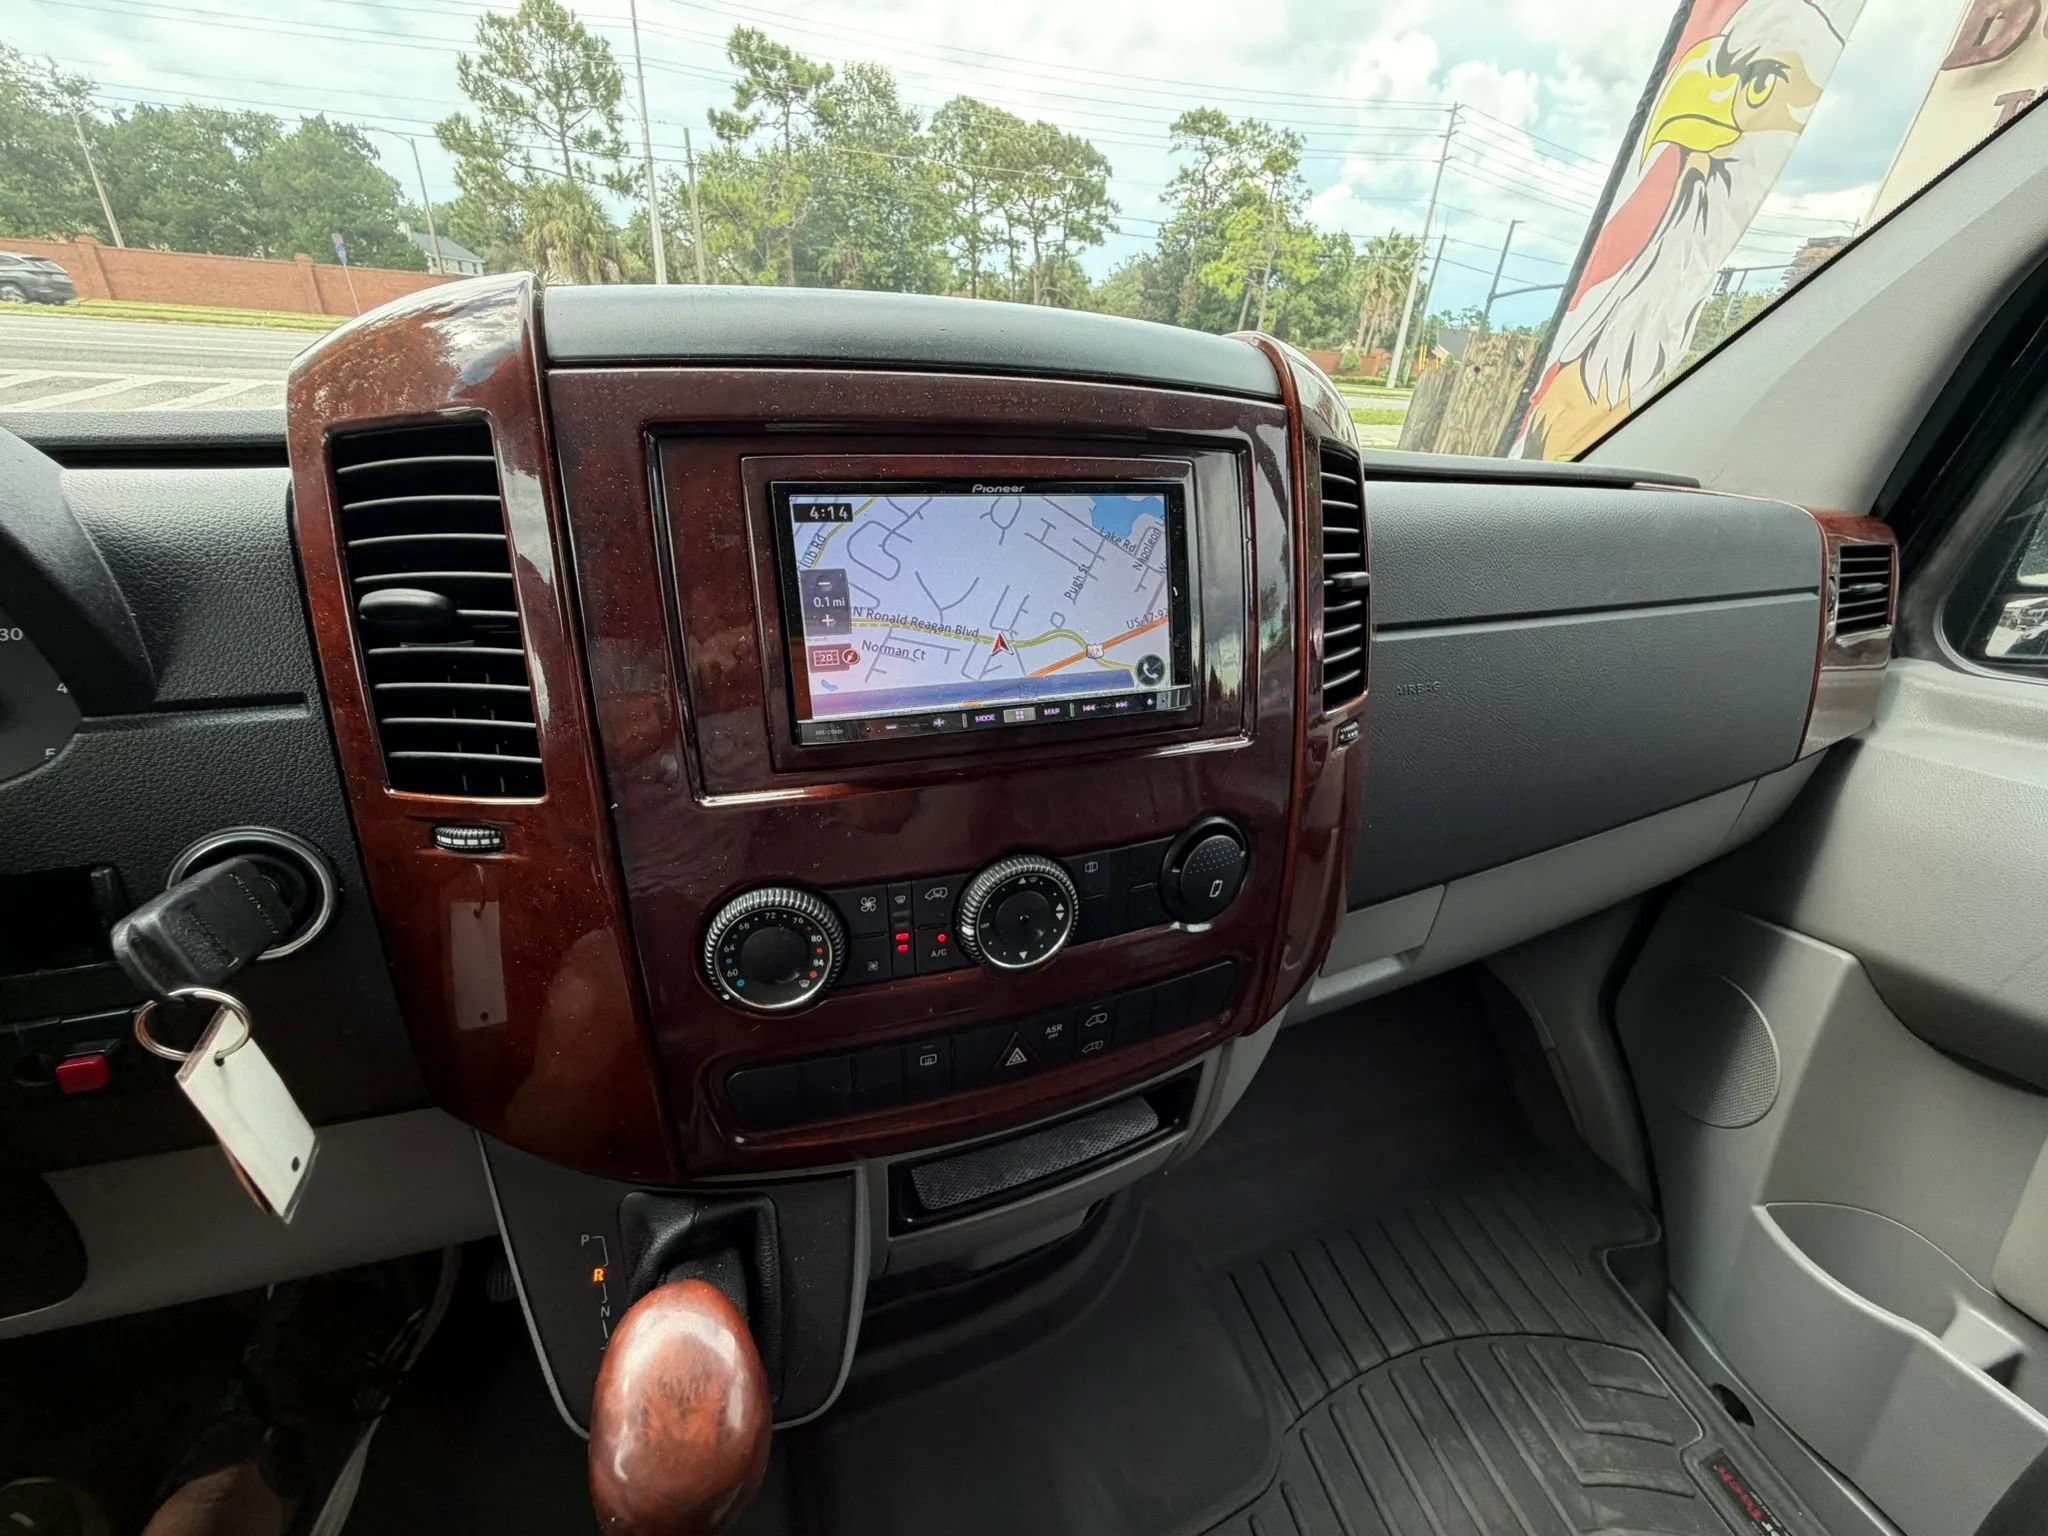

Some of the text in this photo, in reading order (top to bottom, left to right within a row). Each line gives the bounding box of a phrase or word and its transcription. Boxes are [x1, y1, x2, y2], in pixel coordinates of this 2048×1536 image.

[971, 483, 1026, 494] Pioneer
[809, 505, 849, 520] 4:14
[1099, 527, 1137, 553] Lake Rd
[1063, 573, 1085, 600] Pugh
[813, 596, 845, 608] 0.1 mi
[852, 606, 980, 638] N Ronald Reagan Blvd
[861, 639, 926, 661] Norman Ct
[1044, 707, 1060, 716] MAP
[975, 714, 996, 723] MODE
[764, 911, 776, 920] 72
[738, 922, 750, 931] 68
[810, 934, 822, 943] 80
[723, 943, 735, 953] 64
[931, 948, 947, 958] A/C
[812, 958, 824, 967] 84
[726, 968, 739, 978] 60
[1045, 1023, 1063, 1034] ASR
[581, 1234, 590, 1246] P
[593, 1268, 604, 1282] R
[600, 1306, 610, 1318] N
